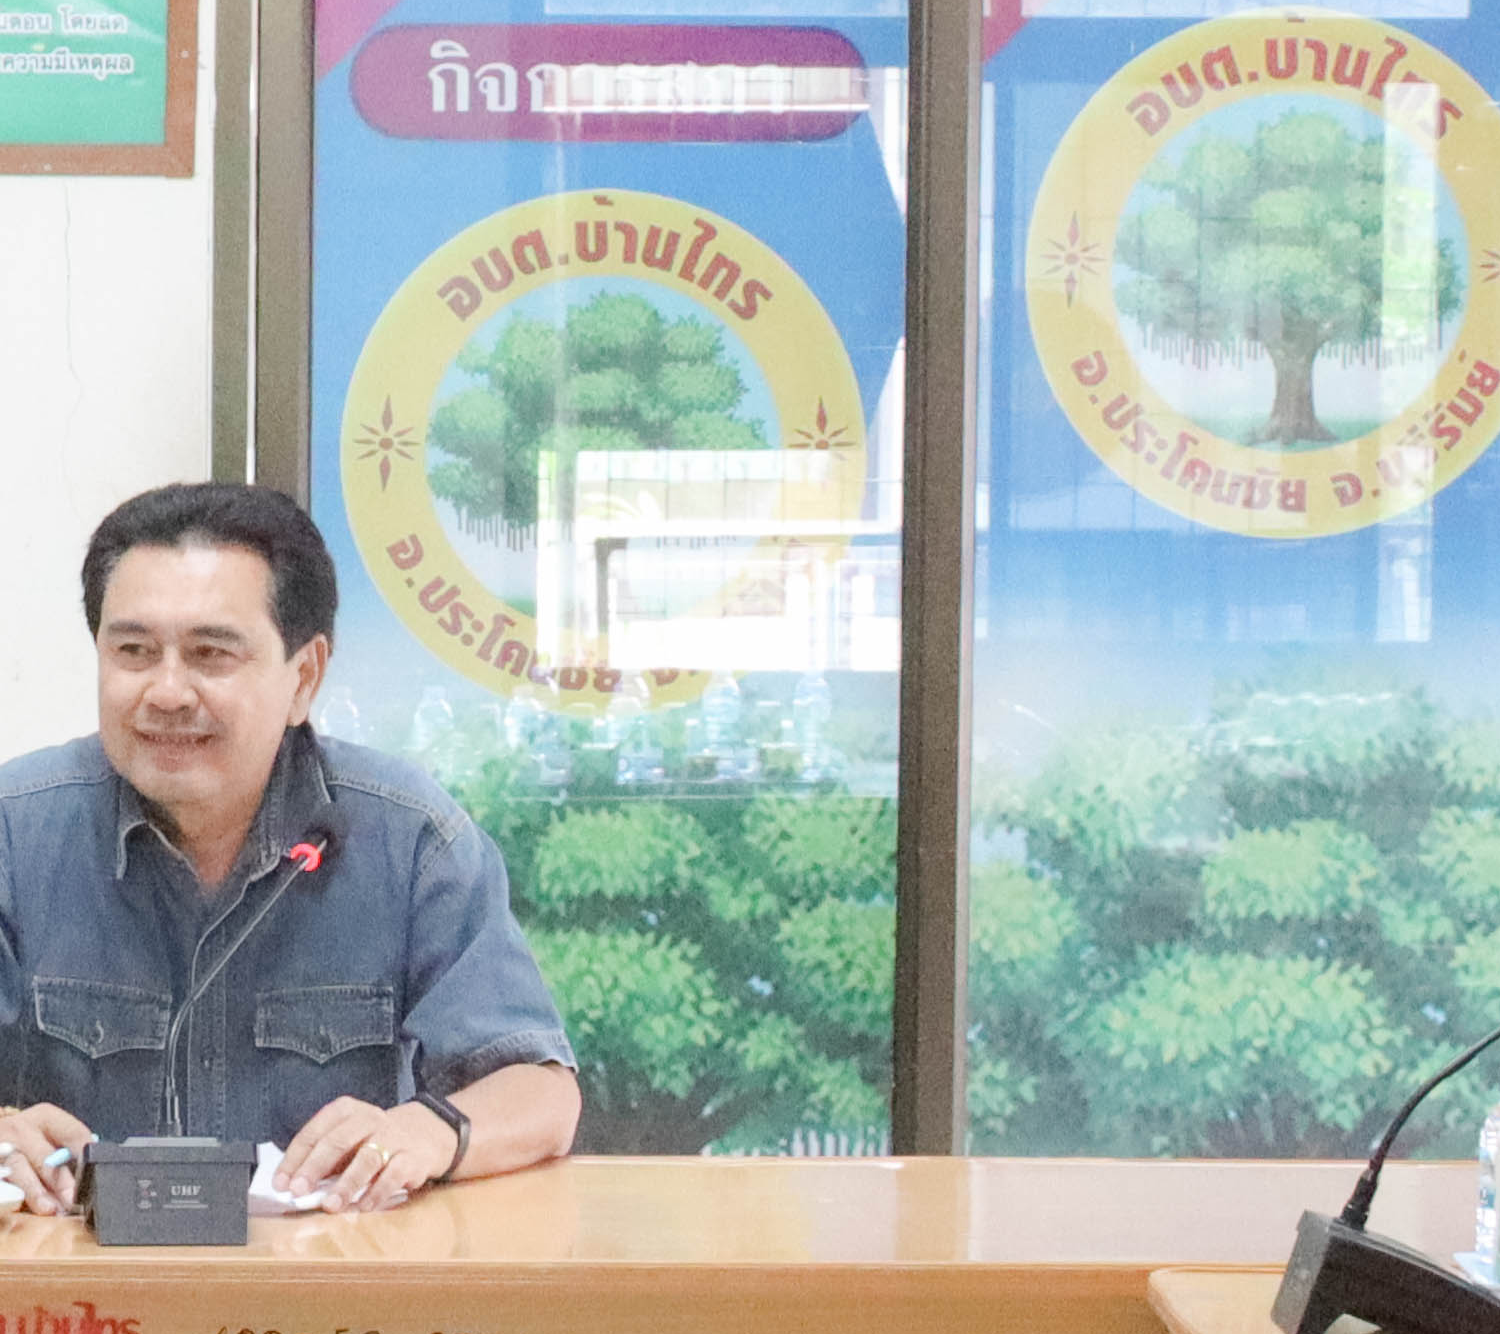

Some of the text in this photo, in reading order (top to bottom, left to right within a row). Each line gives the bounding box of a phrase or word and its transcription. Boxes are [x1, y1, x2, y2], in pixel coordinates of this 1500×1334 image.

[435, 194, 774, 322] อบต.บ้านไทร
[170, 1185, 202, 1197] UHF
